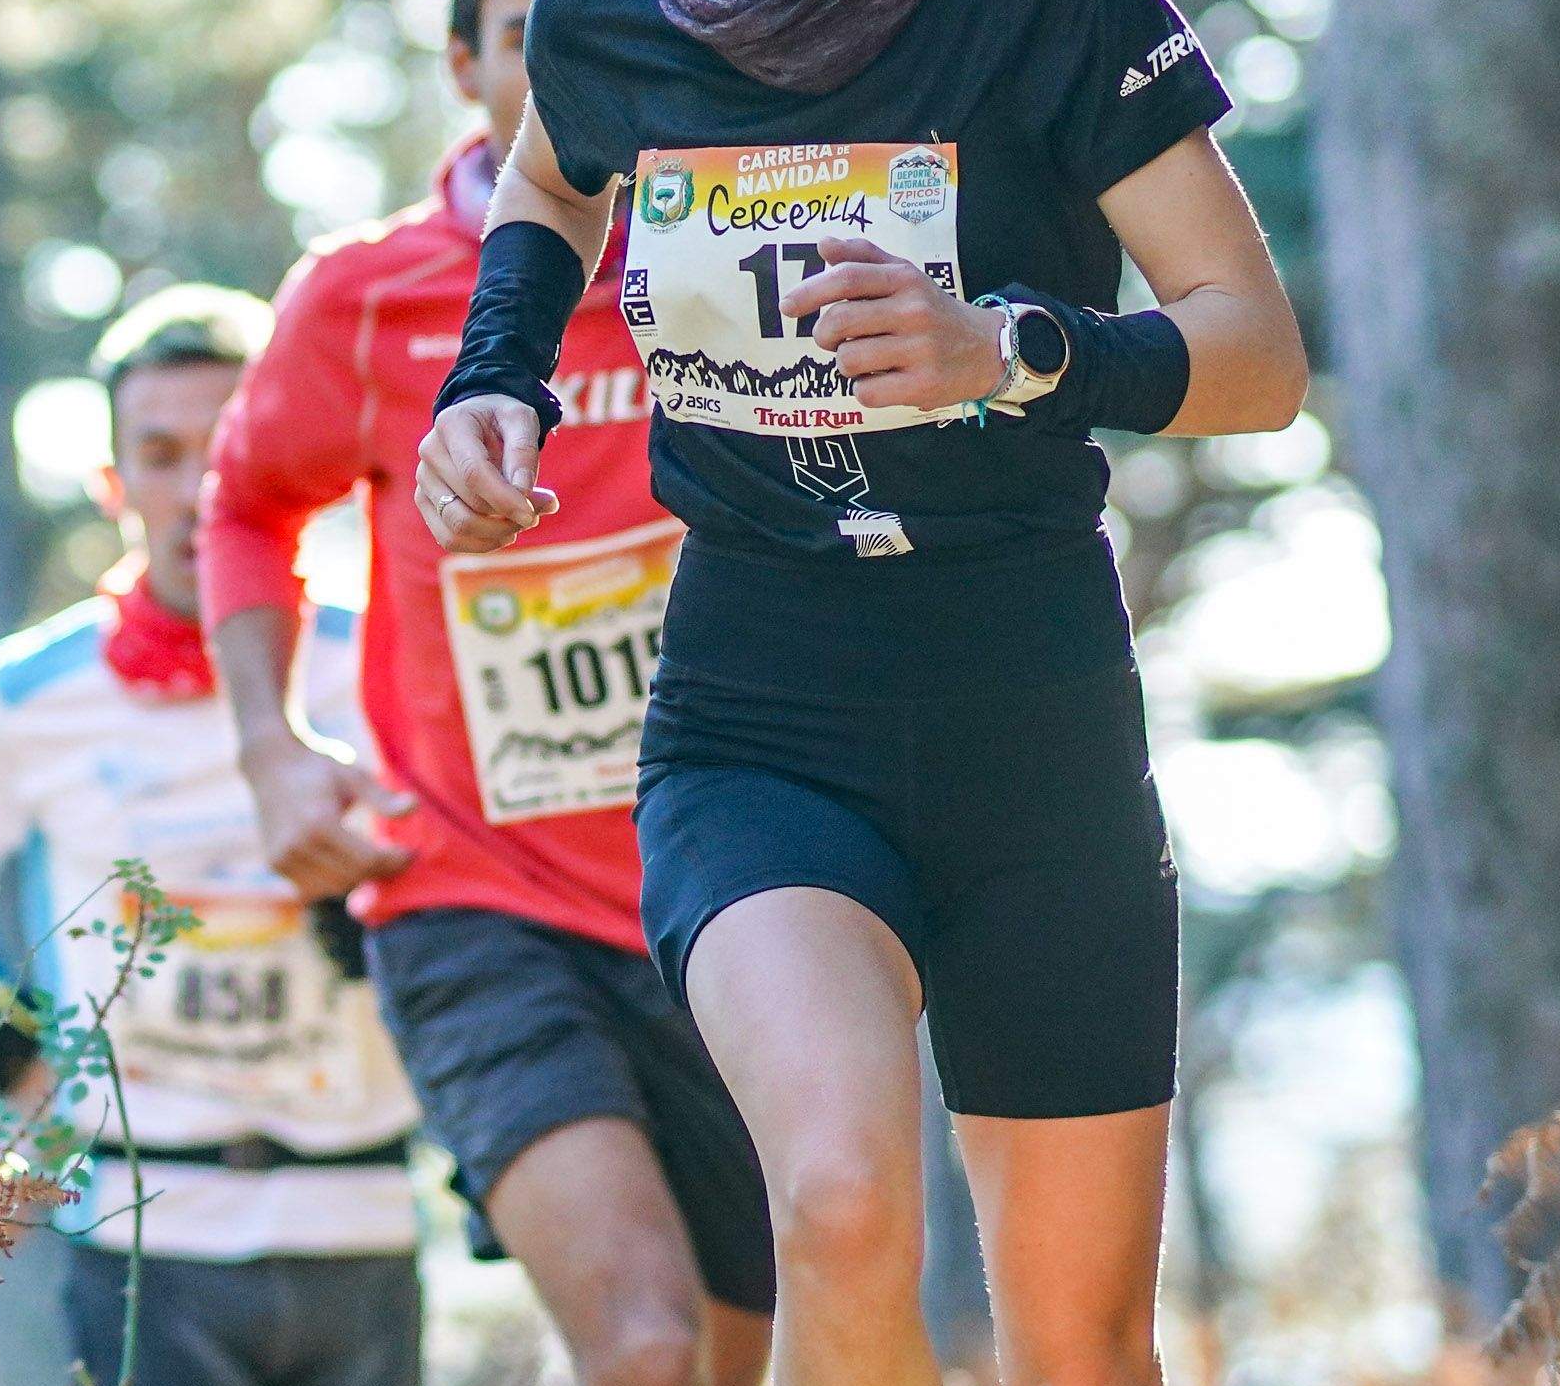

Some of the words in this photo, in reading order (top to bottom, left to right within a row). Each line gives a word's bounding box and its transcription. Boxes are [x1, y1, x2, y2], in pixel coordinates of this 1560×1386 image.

[1120, 74, 1152, 97] adidas
[738, 144, 833, 173] CARRERA
[837, 145, 850, 155] DE
[736, 158, 850, 197] NAVIDAD
[893, 178, 941, 190] NATURALEZA
[894, 191, 904, 205] 7
[906, 188, 940, 199] PICOS
[901, 199, 940, 208] Cercedilla
[686, 395, 721, 413] asics
[753, 407, 809, 428] Trail
[810, 409, 864, 429] Run
